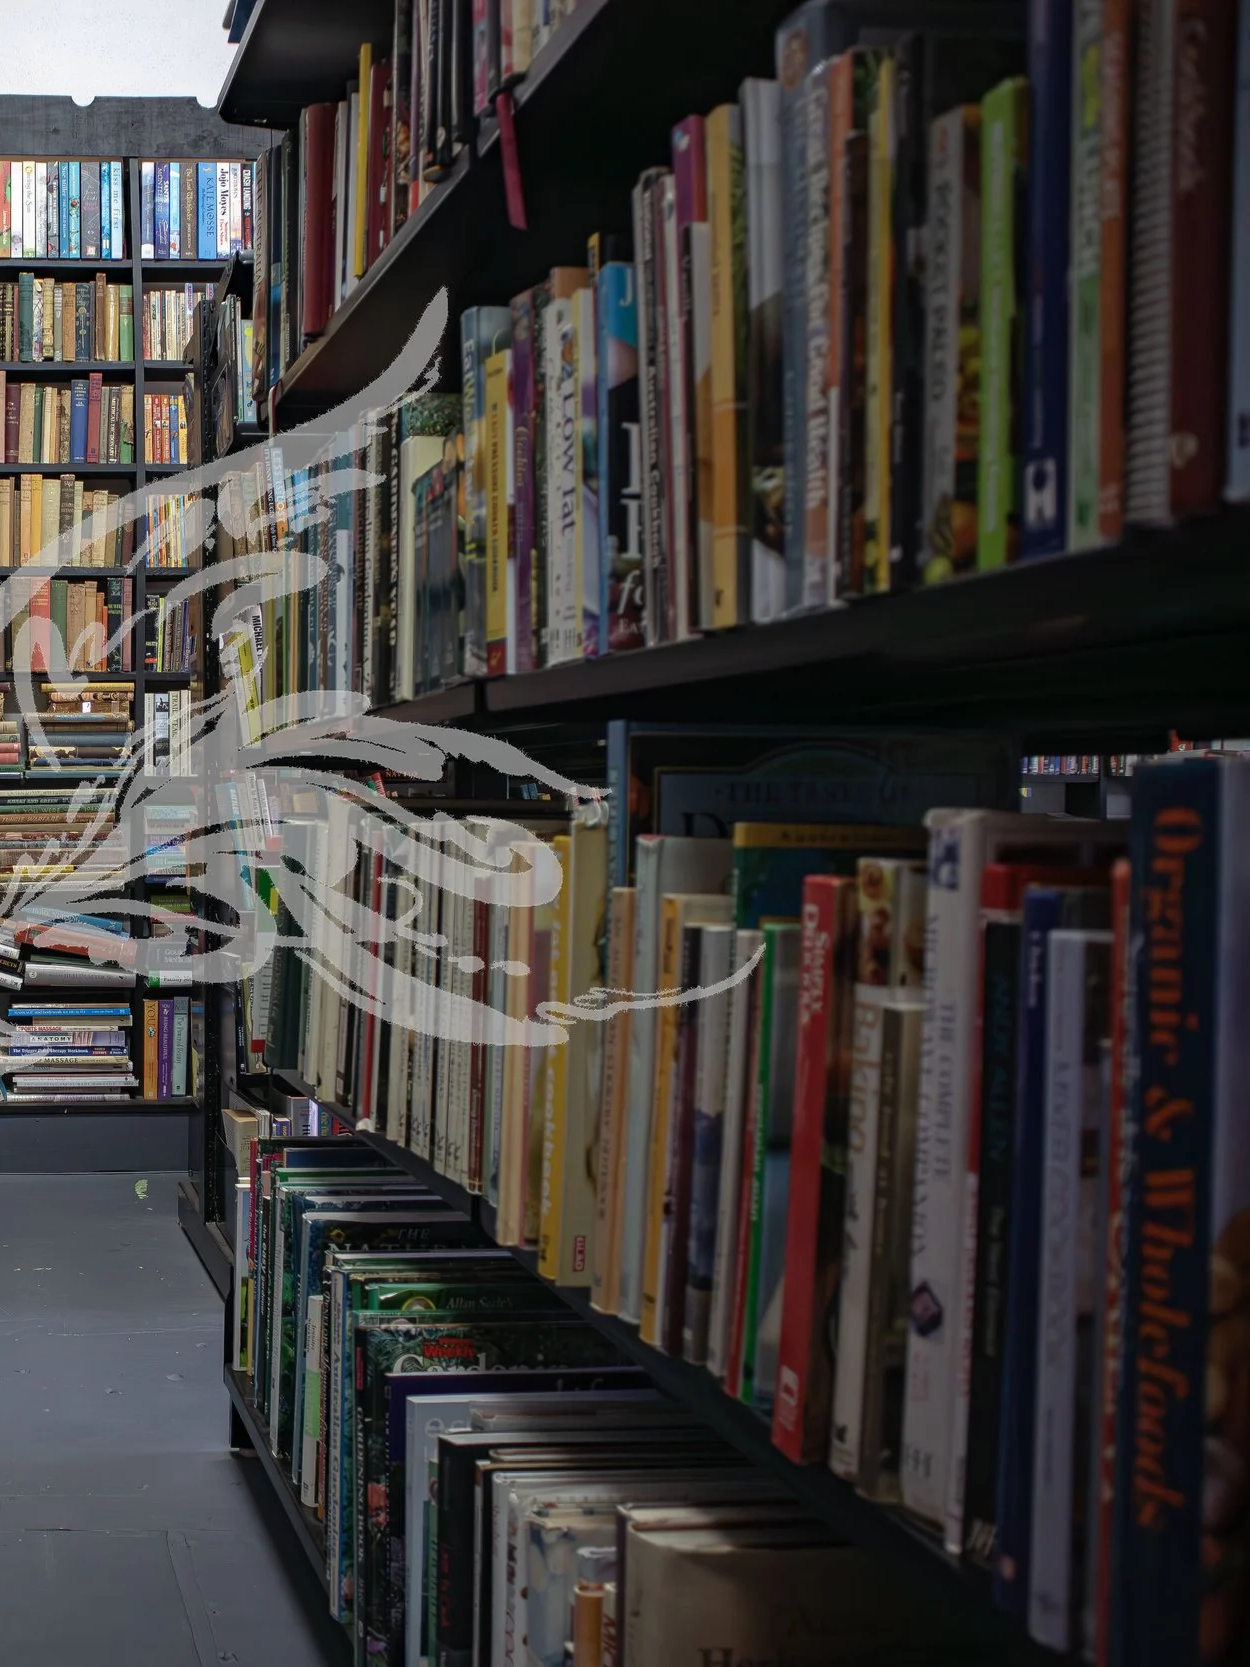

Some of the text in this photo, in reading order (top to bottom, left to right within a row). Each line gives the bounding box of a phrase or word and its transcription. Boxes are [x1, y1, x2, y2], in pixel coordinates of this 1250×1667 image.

[808, 88, 828, 165] Great
[113, 168, 121, 230] kiss me first
[206, 177, 214, 237] KATE MOSSE
[219, 168, 230, 216] Jojo Moyes
[242, 169, 251, 210] CRASH LANDING
[254, 209, 263, 294] AUSTRALIAN
[931, 184, 952, 404] POCKET PALEO
[808, 336, 828, 411] Good
[561, 392, 575, 477] Low
[647, 366, 662, 569] Australian Cookbook
[806, 417, 828, 510] Health
[252, 615, 262, 652] MICHAEL
[362, 555, 372, 648] Gardening
[21, 1048, 37, 1056] Trigger
[49, 1048, 66, 1056] Therapy
[147, 1002, 156, 1027] YOU
[851, 1002, 884, 1155] Baking
[934, 1003, 958, 1184] THE COMPLETE
[989, 974, 1011, 1163] ANDY ALLEN
[540, 1067, 556, 1218] cookbook
[1131, 805, 1207, 1530] Organic & Wholefoods
[260, 1242, 268, 1273] easy
[574, 1237, 586, 1272] GLAD
